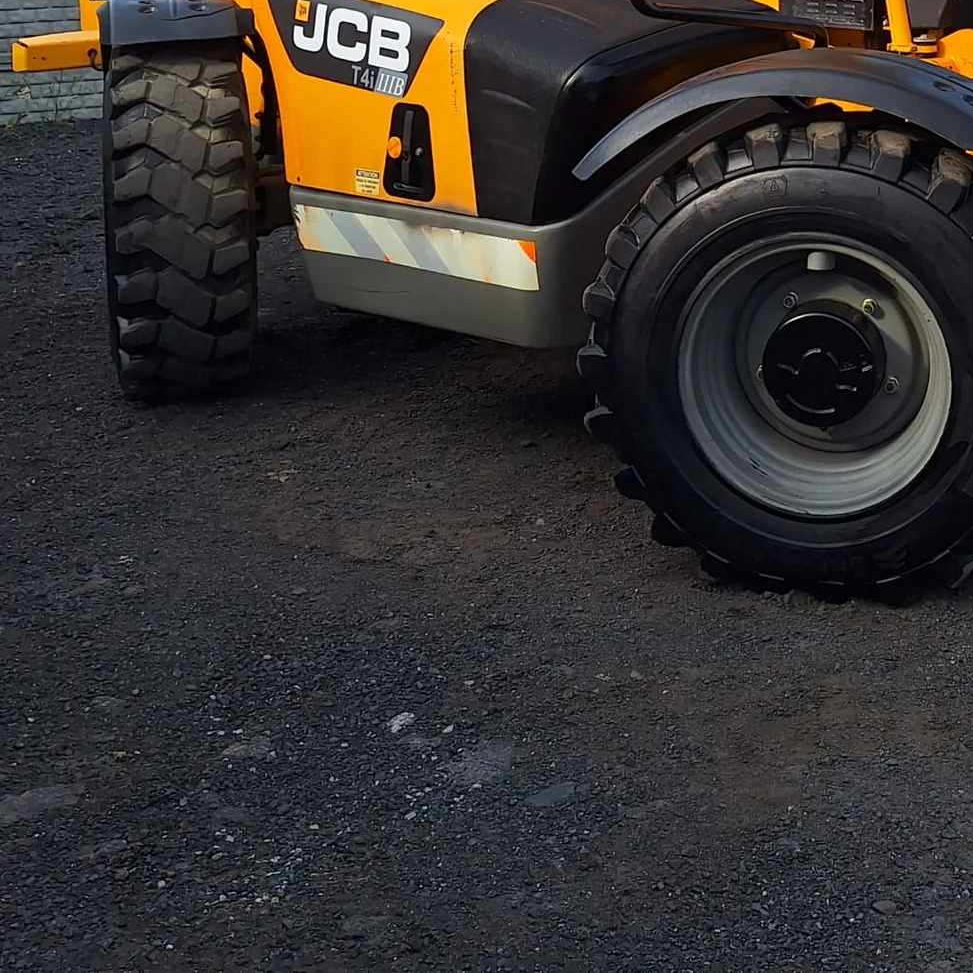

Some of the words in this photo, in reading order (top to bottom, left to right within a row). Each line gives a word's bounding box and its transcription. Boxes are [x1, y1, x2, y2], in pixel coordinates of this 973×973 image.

[293, 3, 411, 72] JCB
[352, 65, 375, 89] T4i
[376, 73, 407, 96] IIIB
